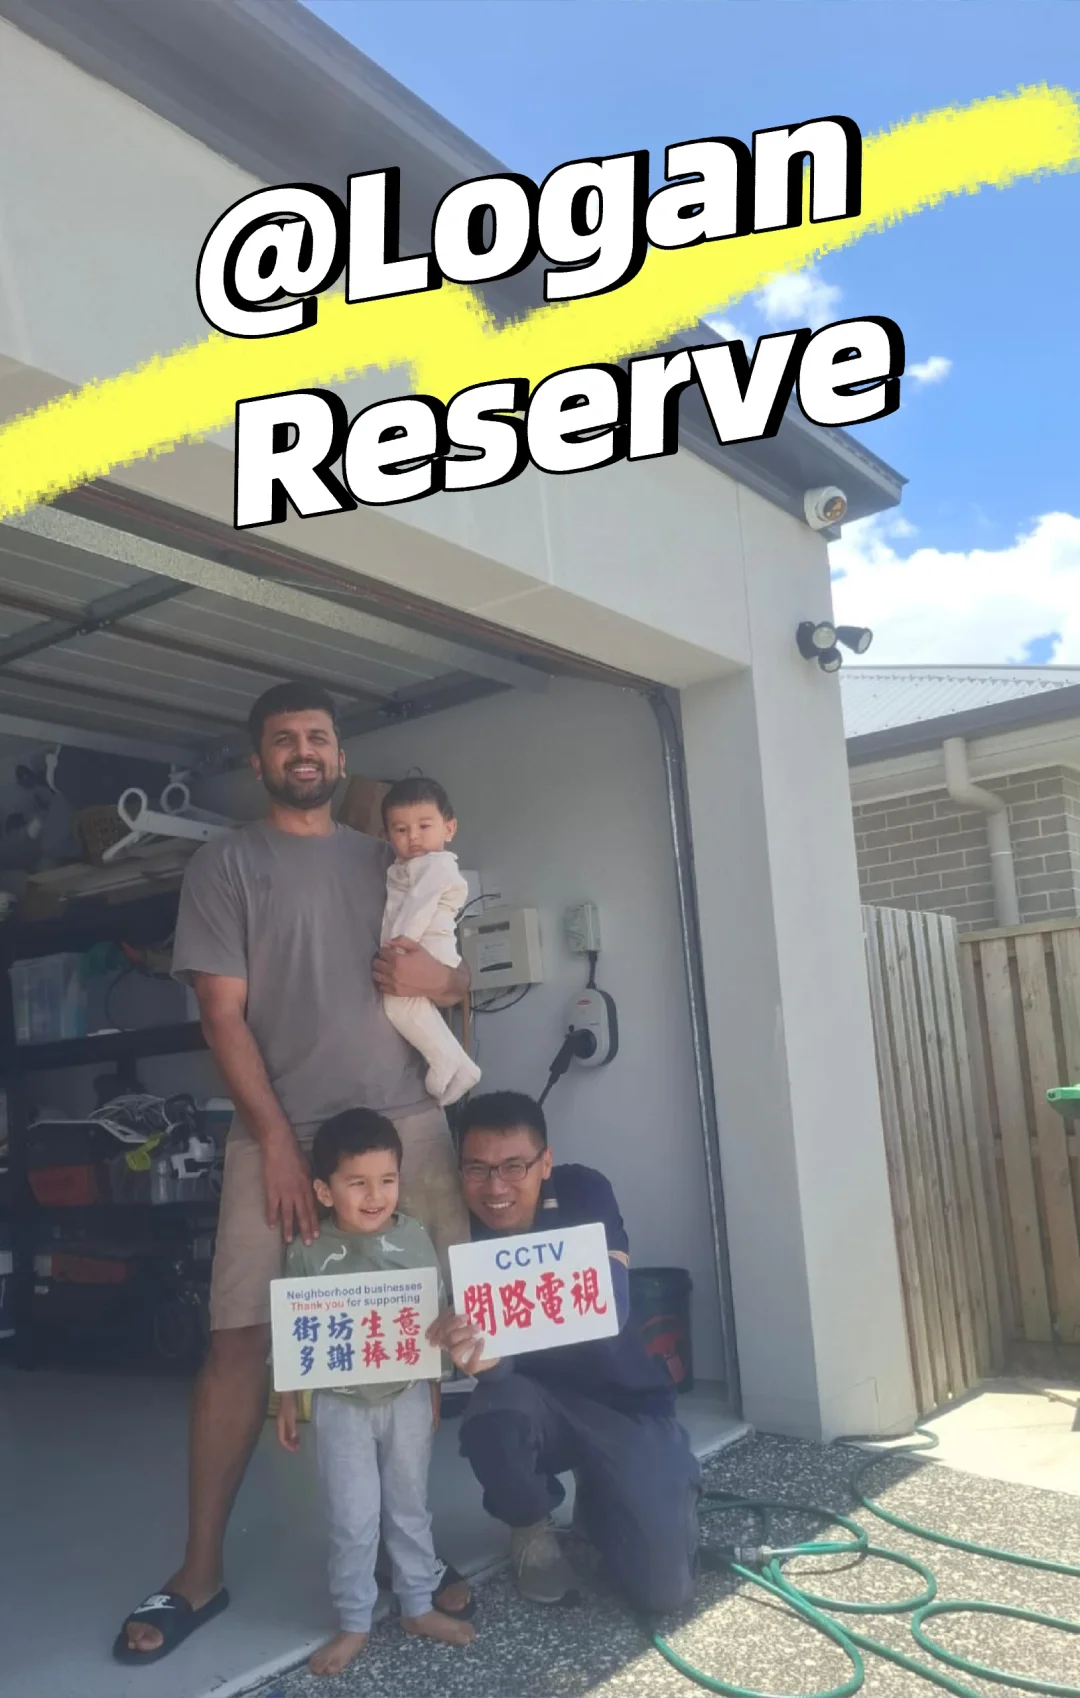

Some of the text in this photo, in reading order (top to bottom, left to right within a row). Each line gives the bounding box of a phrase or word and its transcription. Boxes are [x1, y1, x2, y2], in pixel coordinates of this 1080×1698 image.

[495, 1241, 564, 1270] CCTV
[286, 1282, 423, 1300] Neighborhood businesses
[290, 1294, 421, 1312] Thank you for supporting
[463, 1267, 608, 1337] 閉路電視
[292, 1306, 421, 1343] 街坊生意
